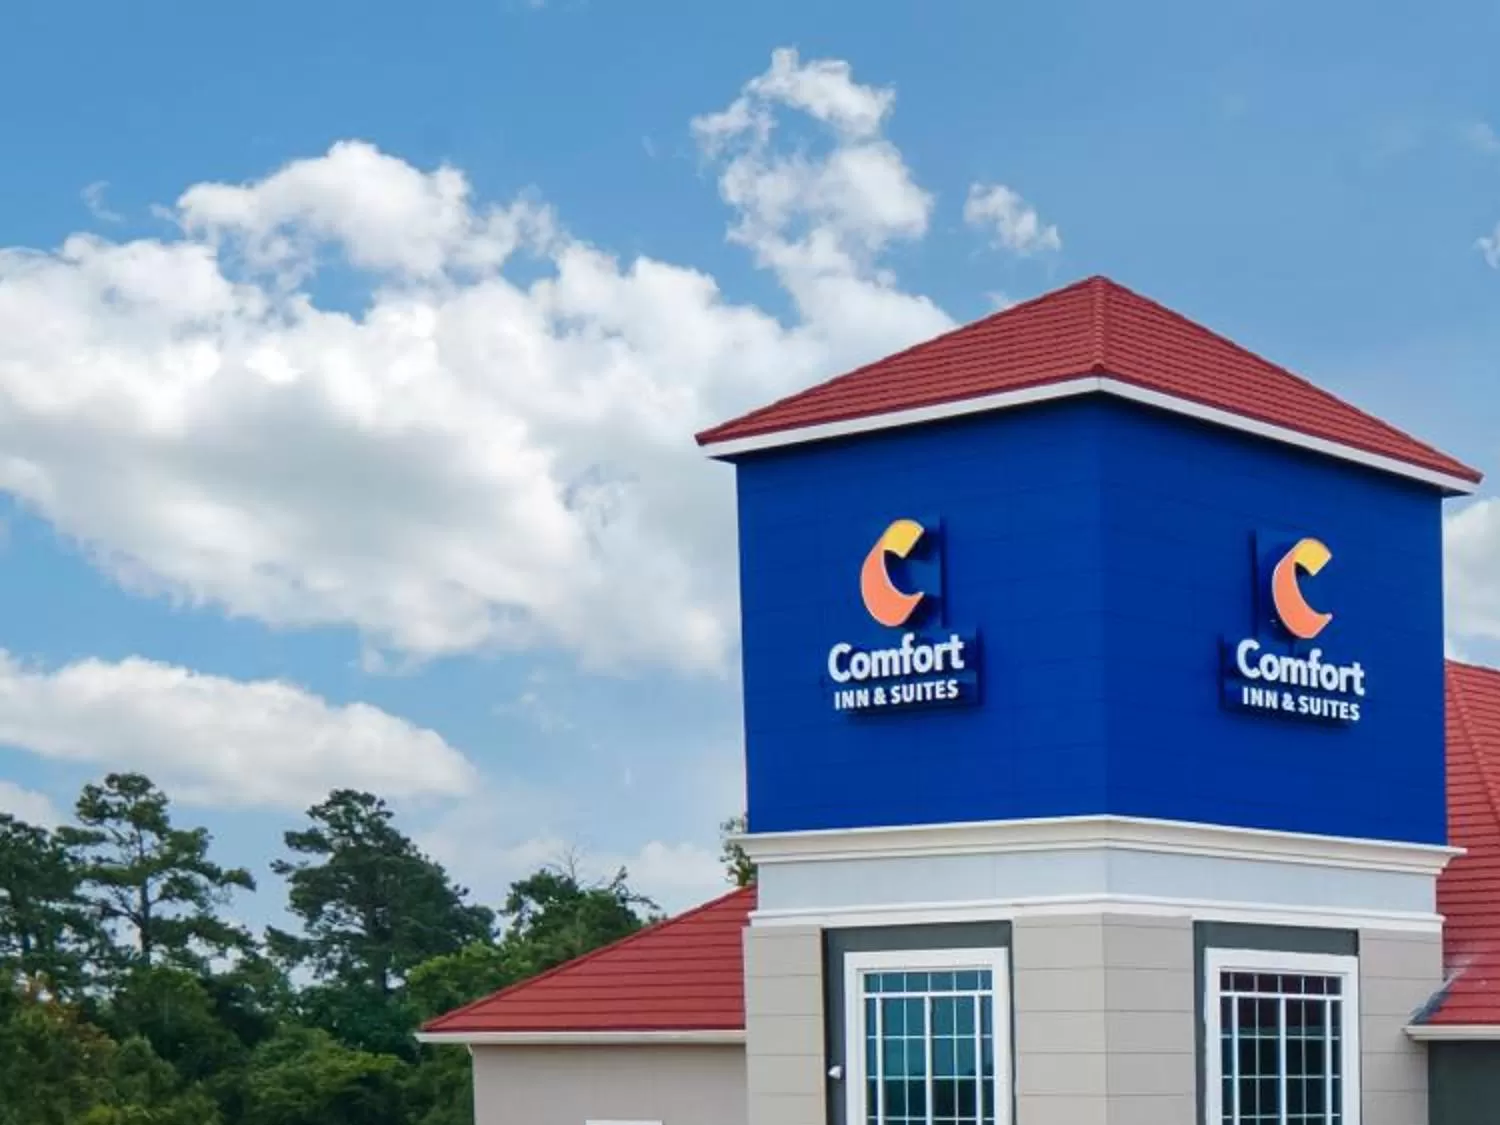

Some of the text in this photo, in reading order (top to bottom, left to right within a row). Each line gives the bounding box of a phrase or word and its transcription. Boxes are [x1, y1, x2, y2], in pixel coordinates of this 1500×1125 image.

[827, 632, 965, 683] Comfort
[1236, 638, 1366, 697] Comfort
[834, 678, 960, 711] INN & SUITES
[1242, 686, 1361, 722] INN & SUITES
